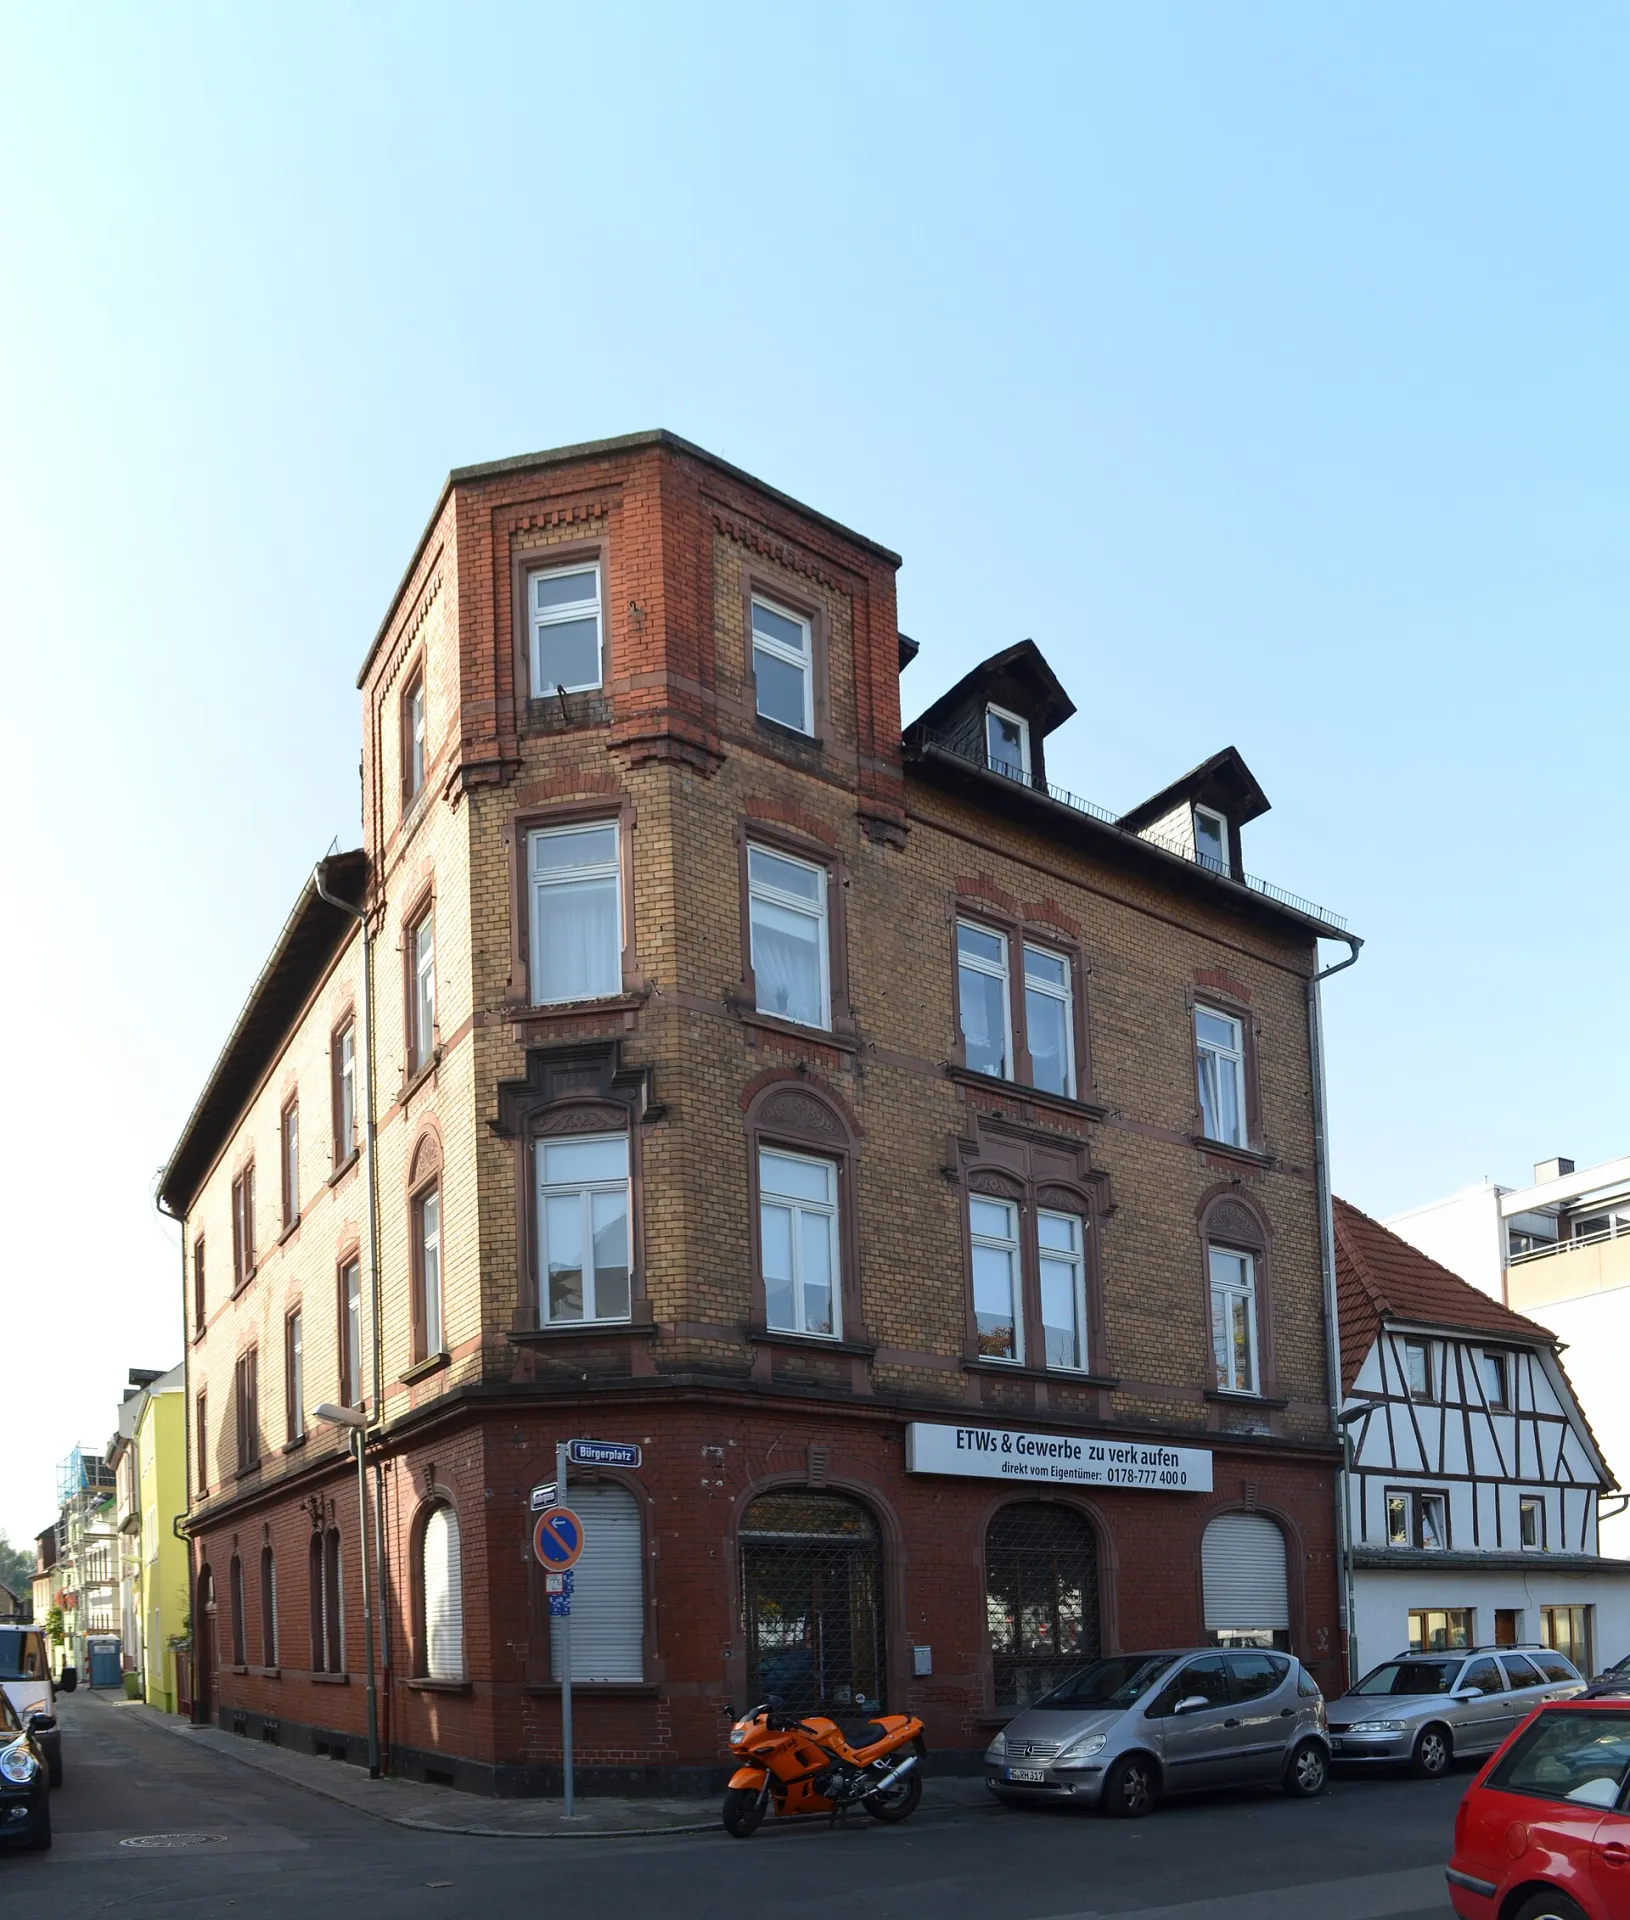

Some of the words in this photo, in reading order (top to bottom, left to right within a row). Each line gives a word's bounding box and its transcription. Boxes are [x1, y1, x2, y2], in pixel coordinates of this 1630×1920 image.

[580, 1446, 631, 1461] Bürgerplatz
[956, 1429, 997, 1452] ETWs
[1001, 1433, 1012, 1453] &
[1016, 1435, 1082, 1459] Gewerbe
[1088, 1445, 1105, 1461] zu
[1001, 1461, 1028, 1475] direkt
[1030, 1465, 1049, 1477] vom
[1050, 1465, 1102, 1480] Eigentümer:
